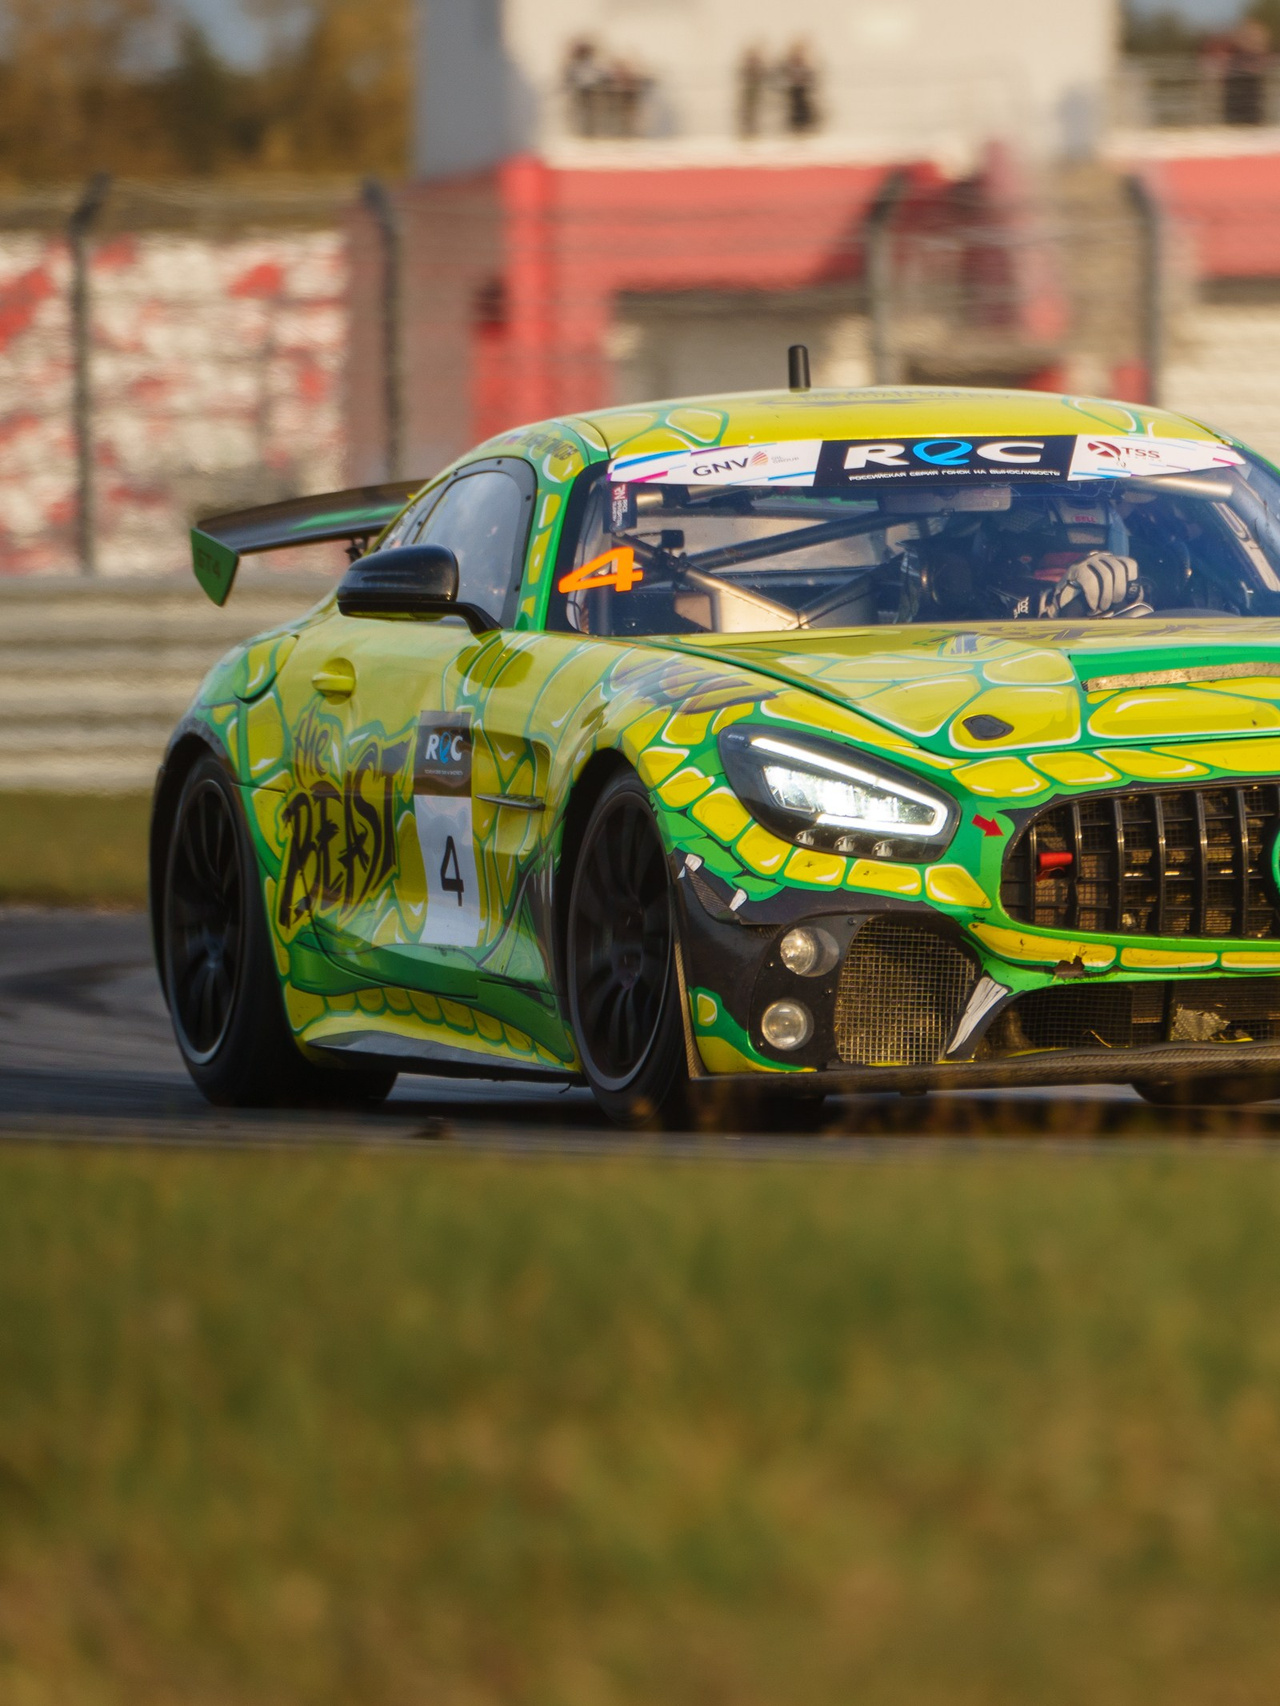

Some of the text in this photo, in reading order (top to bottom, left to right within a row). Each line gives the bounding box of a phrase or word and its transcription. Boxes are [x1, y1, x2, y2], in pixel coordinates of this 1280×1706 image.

[1121, 446, 1160, 459] TSS
[693, 457, 749, 476] GNV
[849, 471, 907, 481] РОССИЙСКАЯ
[909, 469, 939, 477] СЕРИЯ
[990, 468, 1060, 477] ВЫНОСЛИВОСТЬ
[558, 545, 643, 594] 4
[441, 835, 464, 907] 4
